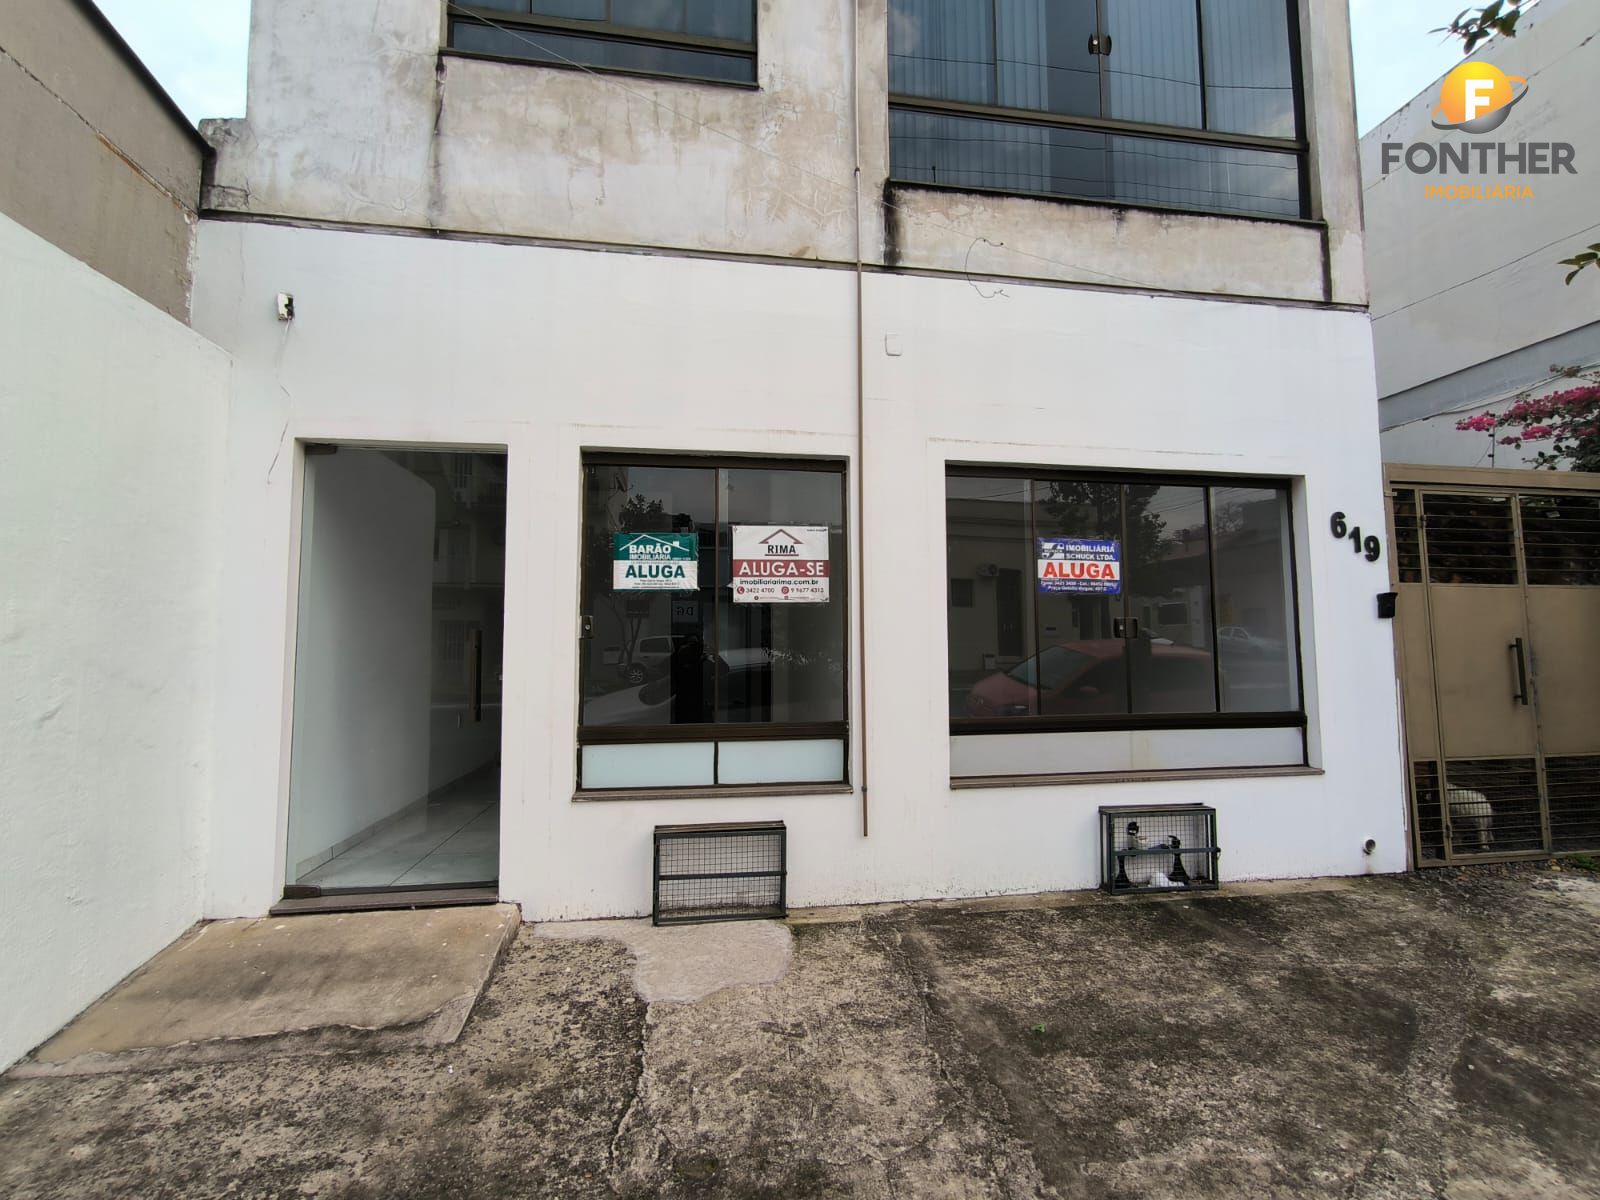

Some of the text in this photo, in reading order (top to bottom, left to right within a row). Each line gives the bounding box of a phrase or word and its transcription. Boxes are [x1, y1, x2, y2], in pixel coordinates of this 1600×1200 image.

[1330, 511, 1380, 562] 619
[629, 543, 671, 554] BARÃO
[767, 545, 796, 554] RIMA
[1066, 543, 1115, 553] IMOBILIÁRIA
[625, 565, 685, 578] ALUGA
[739, 561, 824, 576] ALUGA-SE
[1043, 562, 1115, 578] ALUGA
